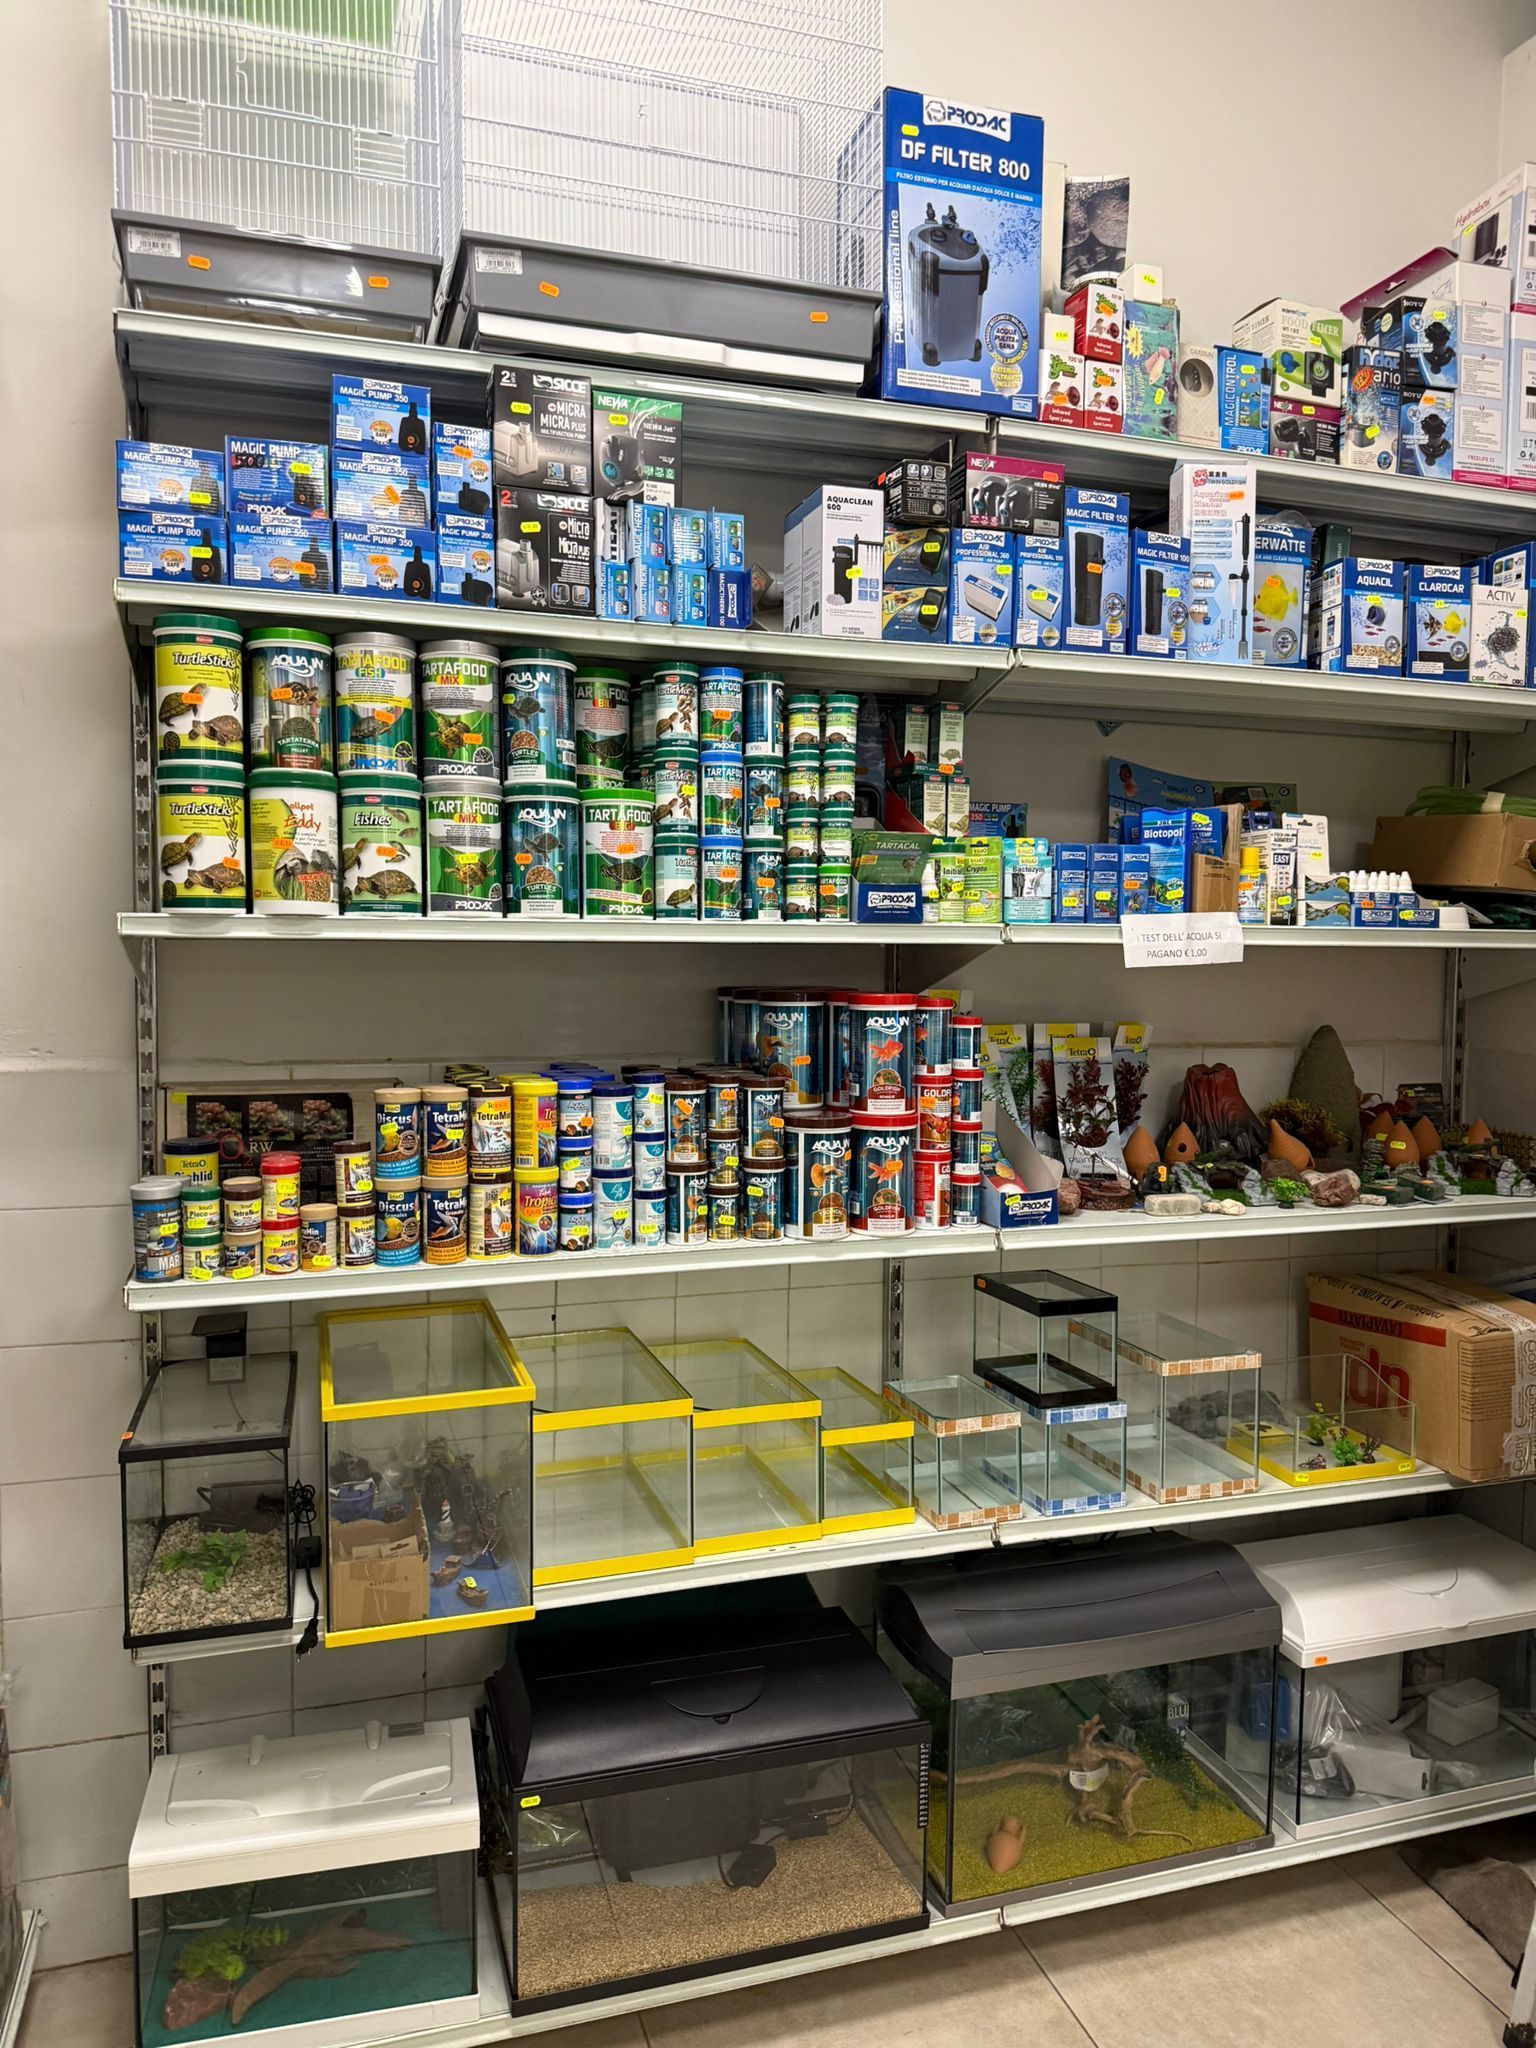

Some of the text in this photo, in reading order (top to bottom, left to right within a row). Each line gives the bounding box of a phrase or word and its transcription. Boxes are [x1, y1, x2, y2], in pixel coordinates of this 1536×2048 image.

[947, 106, 1008, 132] PRODAC
[901, 139, 1030, 181] DF FILTER 800
[896, 171, 913, 181] FILTRO
[914, 174, 937, 185] ESTERNO
[938, 178, 948, 186] PER
[949, 180, 971, 192] ACQUARI
[972, 184, 993, 194] D'ACQUA
[994, 188, 1010, 198] DOLCE
[1015, 192, 1034, 202] MARINA
[889, 208, 904, 344] Professional line
[996, 327, 1016, 336] ACQUA
[501, 370, 588, 393] 2 SICCE
[1373, 369, 1400, 384] ario
[373, 380, 400, 392] PRODAC
[1225, 355, 1236, 427] MAGICONTROL
[339, 386, 409, 403] MAGIC PUMP 350
[597, 394, 629, 409] NEWA
[556, 401, 587, 419] MICRA
[1051, 407, 1072, 417] Infrared
[540, 413, 587, 433] MICRA PLUS
[1049, 415, 1074, 424] Spot Lamp
[436, 436, 459, 445] MAGIC
[161, 445, 191, 457] PRODAC
[231, 440, 301, 458] MAGIC PUMP
[339, 461, 367, 473] MAGIC
[368, 464, 391, 475] PUMP
[970, 457, 995, 470] NEWA
[501, 490, 589, 511] 2 SICCE
[826, 495, 873, 507] AQUACLEAN
[1088, 492, 1116, 506] PRODAC
[247, 504, 286, 515] PRODAC
[826, 503, 842, 512] 600
[163, 515, 193, 526] PRODAC
[1066, 507, 1128, 523] MAGIC FILTER 150
[270, 517, 300, 527] PRODAC
[456, 516, 484, 528] PRODAC
[567, 517, 590, 535] Micra
[127, 523, 201, 537] MAGIC PUMP 800
[236, 524, 264, 536] MAGIC
[266, 527, 292, 537] PUMP
[376, 526, 406, 538] PRODAC
[440, 526, 459, 536] MAGIC
[461, 530, 480, 538] PUMP
[344, 531, 413, 547] MAGIC PUMP 350
[558, 536, 577, 553] Micra
[973, 532, 1003, 545] PRODAC
[1033, 536, 1058, 549] PRODAC
[1157, 532, 1180, 545] PRODAC
[978, 543, 990, 551] AIR
[1255, 536, 1306, 554] ERWATTE
[955, 548, 998, 560] PROFESSIONAL
[1020, 551, 1054, 561] PROFESSIONAL
[1137, 547, 1190, 563] MAGIC FILTER 100
[1367, 561, 1391, 572] PRODAC
[1434, 566, 1459, 577] PRODAC
[1356, 575, 1393, 588] AQUACIL
[1418, 581, 1464, 594] CLAROCAR
[1487, 589, 1516, 603] ACTIV
[173, 651, 236, 670] TurtleSticks
[338, 651, 407, 673] TARTAFOOD
[358, 667, 382, 678] FISH
[421, 661, 487, 678] TARTAFOOD
[439, 675, 460, 685] MIX
[276, 736, 319, 750] TARTATERRA
[511, 749, 539, 759] TURTLES
[355, 758, 397, 770] PRODAC
[438, 764, 478, 775] PRODAC
[169, 801, 233, 818] TurtleSticks
[432, 799, 499, 817] TARTAFOOD
[970, 802, 1011, 812] MAGIC PUMP
[354, 811, 393, 827] Fishes
[458, 813, 479, 824] MIX
[589, 808, 651, 823] TARTAFOOD
[283, 811, 321, 833] Eddy
[614, 822, 630, 831] BIG
[1143, 827, 1183, 840] Biotopol
[876, 840, 920, 850] TARTACAL
[1274, 854, 1290, 863] EASY
[965, 865, 987, 874] Crypto
[1012, 865, 1045, 874] Bactozym
[526, 884, 557, 893] TURTLES
[881, 892, 914, 905] PRODAC
[455, 900, 493, 911] PRODAC
[609, 904, 644, 915] PRODAC
[1142, 932, 1160, 943] TEST
[1163, 931, 1184, 942] DELL'
[1186, 931, 1214, 942] ACQUA
[1215, 931, 1222, 941] SI
[1147, 948, 1182, 959] PAGANO
[873, 1084, 901, 1093] GOLDFISH
[377, 1113, 411, 1124] Discus
[379, 1200, 414, 1212] Discus
[1021, 1199, 1051, 1211] PRODAC
[189, 1210, 208, 1218] Pleco
